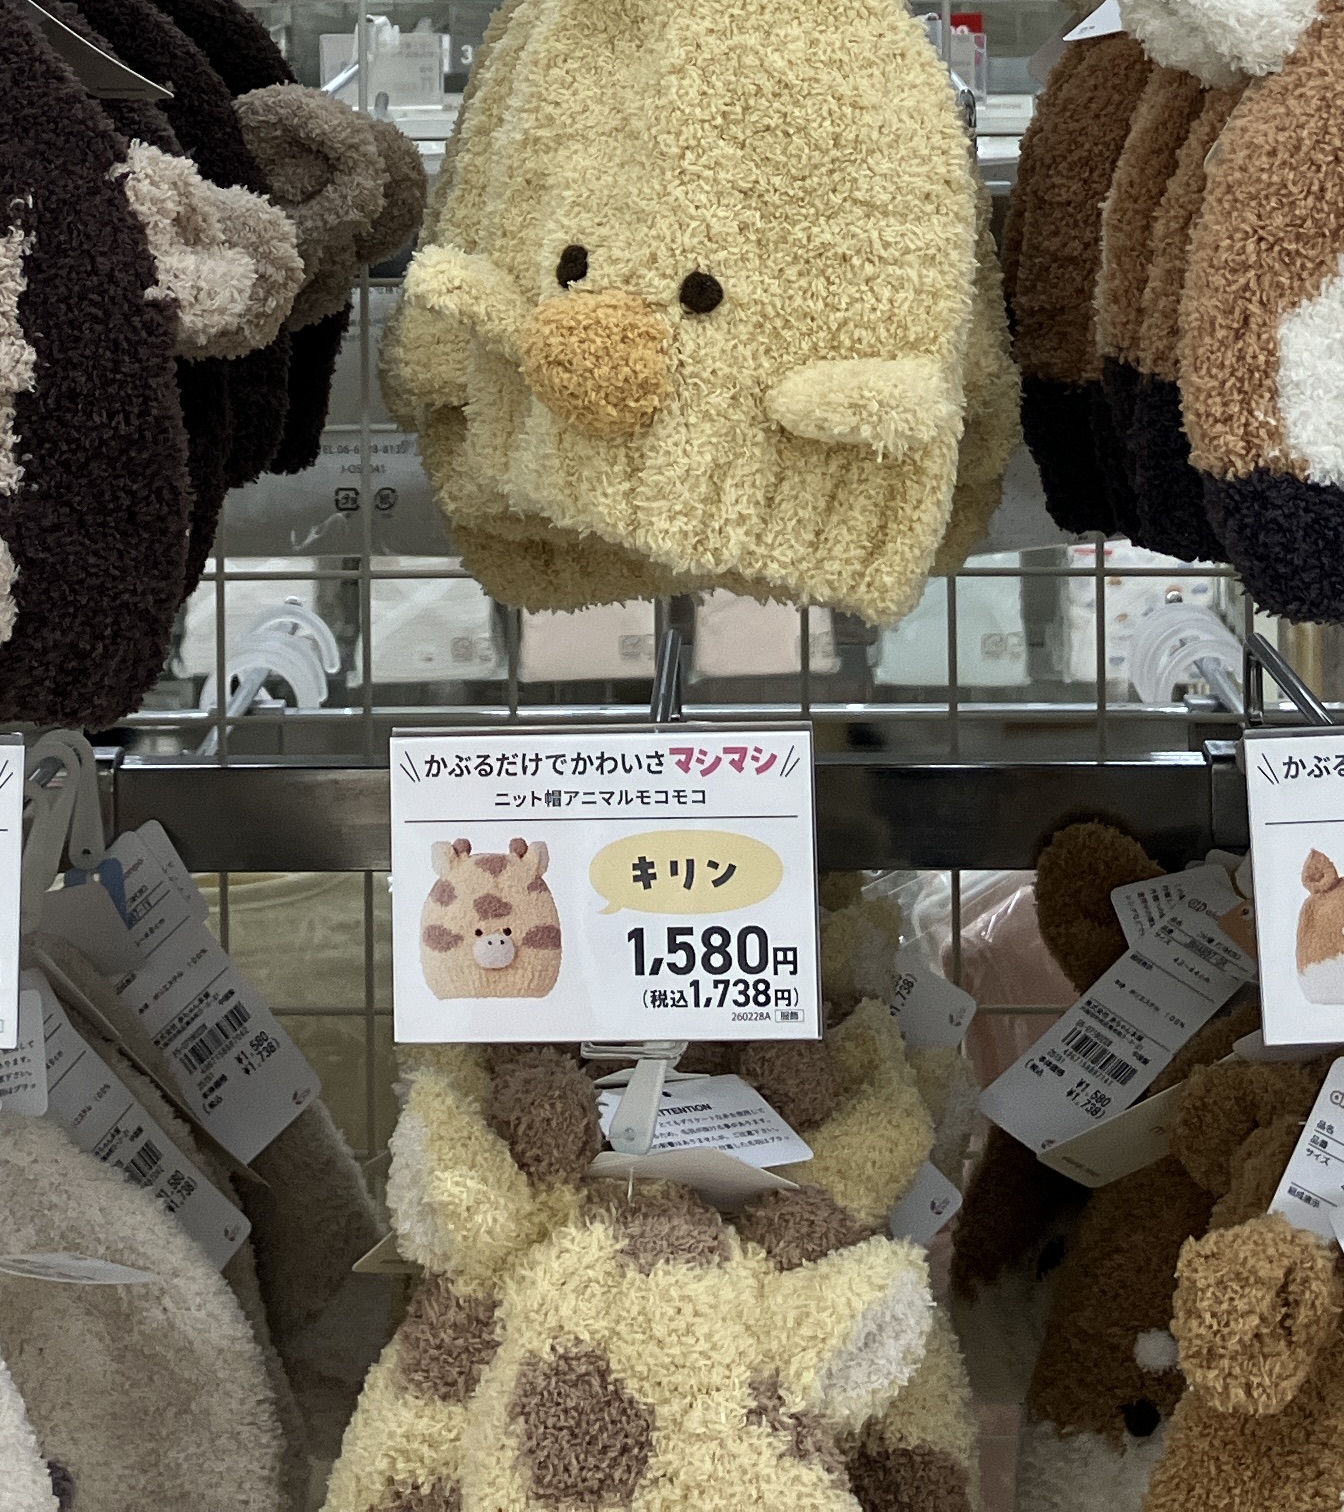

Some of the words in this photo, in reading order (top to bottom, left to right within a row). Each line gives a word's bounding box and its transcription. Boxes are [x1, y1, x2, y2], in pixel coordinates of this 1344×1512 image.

[424, 746, 778, 778] かぶるだけでかわいさマシマシ
[494, 790, 707, 807] ニット帽アニマルモコモコ
[631, 856, 737, 890] キリン
[627, 925, 798, 976] 1,580円
[1306, 1148, 1331, 1166] サイズ
